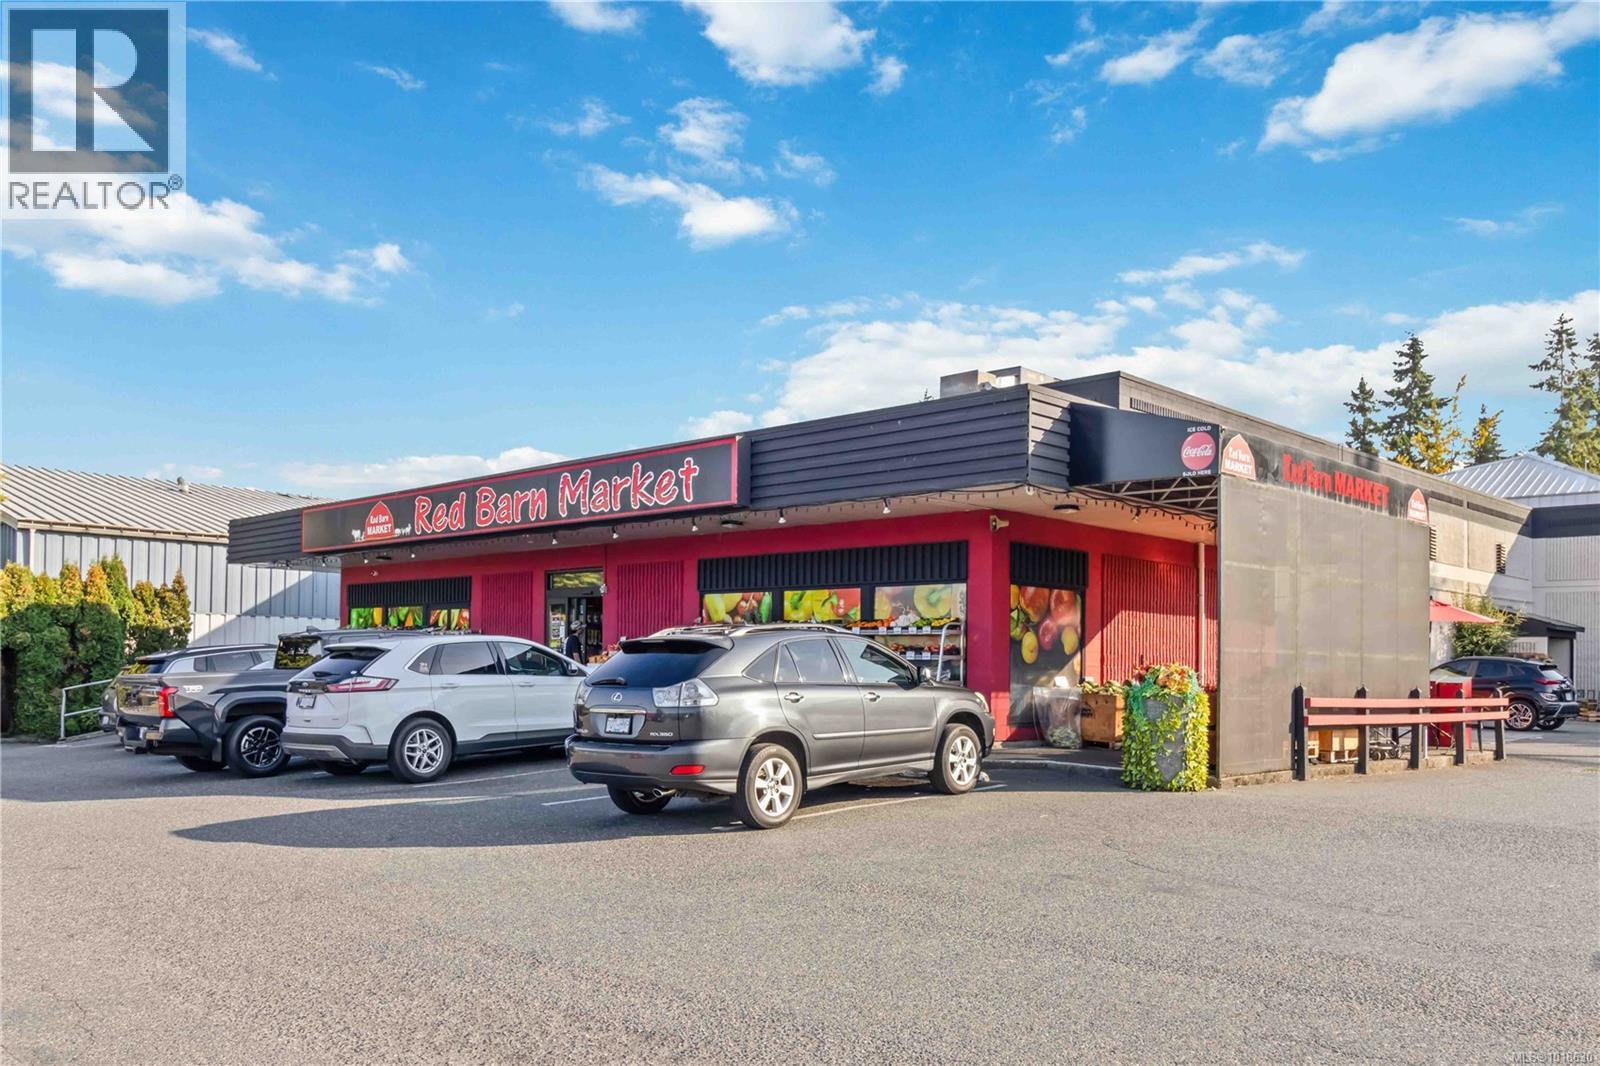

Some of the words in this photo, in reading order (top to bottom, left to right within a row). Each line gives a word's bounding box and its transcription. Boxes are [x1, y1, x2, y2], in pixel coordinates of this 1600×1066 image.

[414, 492, 466, 535] Red
[475, 486, 548, 528] Barn
[558, 457, 699, 518] Market
[1334, 470, 1390, 511] MARKET
[367, 524, 392, 535] MARKET
